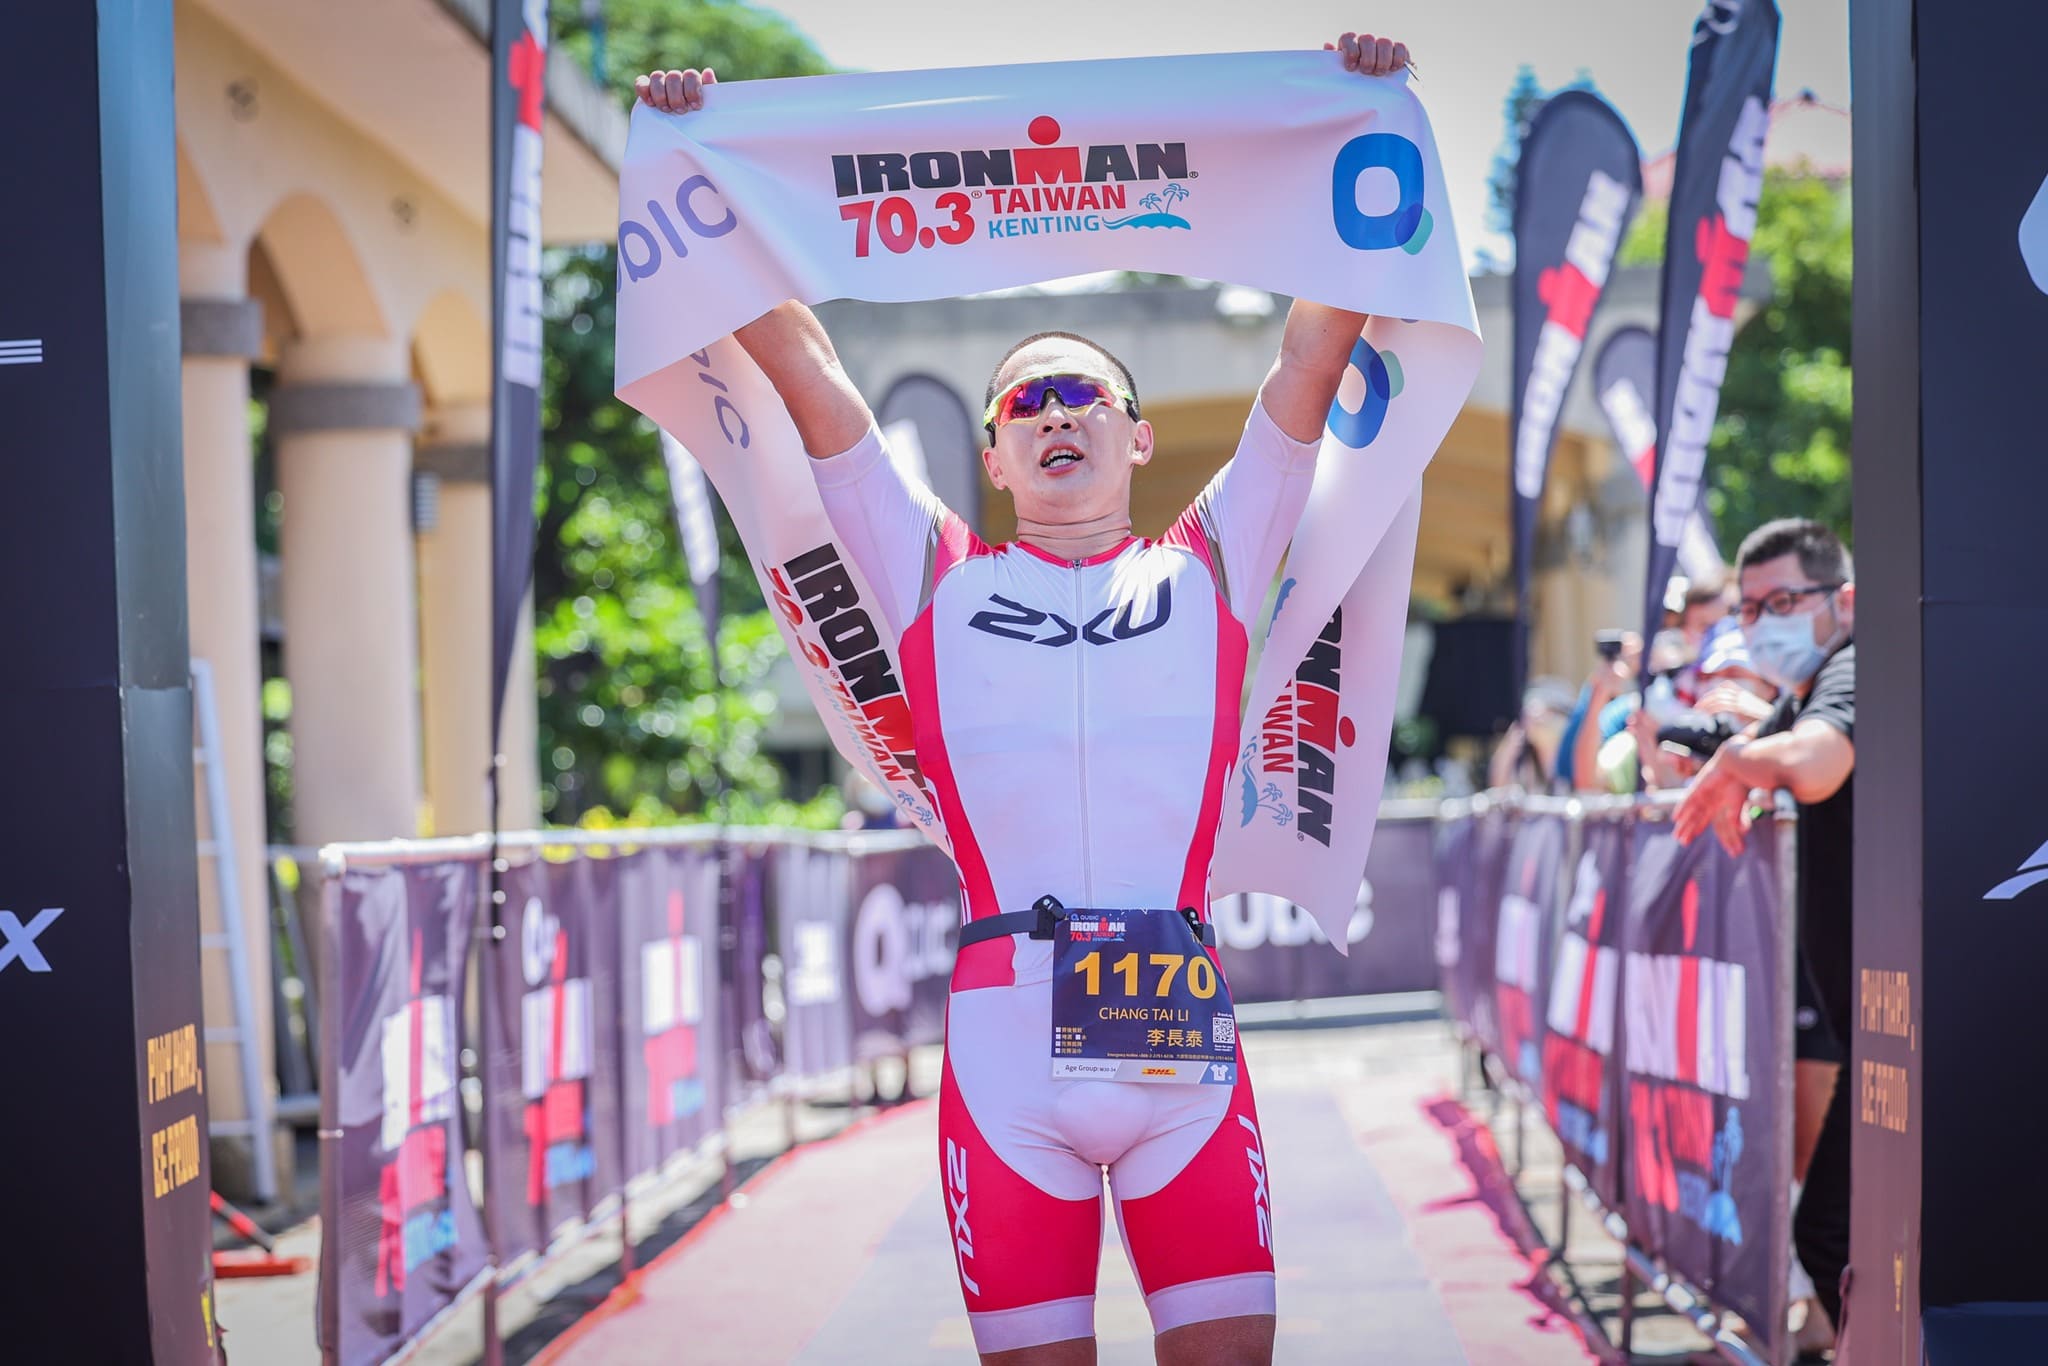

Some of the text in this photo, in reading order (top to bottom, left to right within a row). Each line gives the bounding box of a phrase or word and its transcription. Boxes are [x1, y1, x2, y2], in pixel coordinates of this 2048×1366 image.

[832, 117, 1190, 198] IRONMAN
[985, 185, 1127, 214] TAIWAN
[838, 192, 976, 258] 70.3
[988, 215, 1101, 240] KENTING
[968, 576, 1172, 648] 2XU
[1070, 917, 1127, 932] IRONMAN
[1070, 931, 1092, 943] 70.3
[1074, 951, 1217, 1000] 1170
[1099, 1007, 1189, 1022] CHANG TAI LI
[1146, 1028, 1204, 1049] 李長泰
[1064, 1064, 1078, 1073] Age
[1145, 1067, 1173, 1076] DHL
